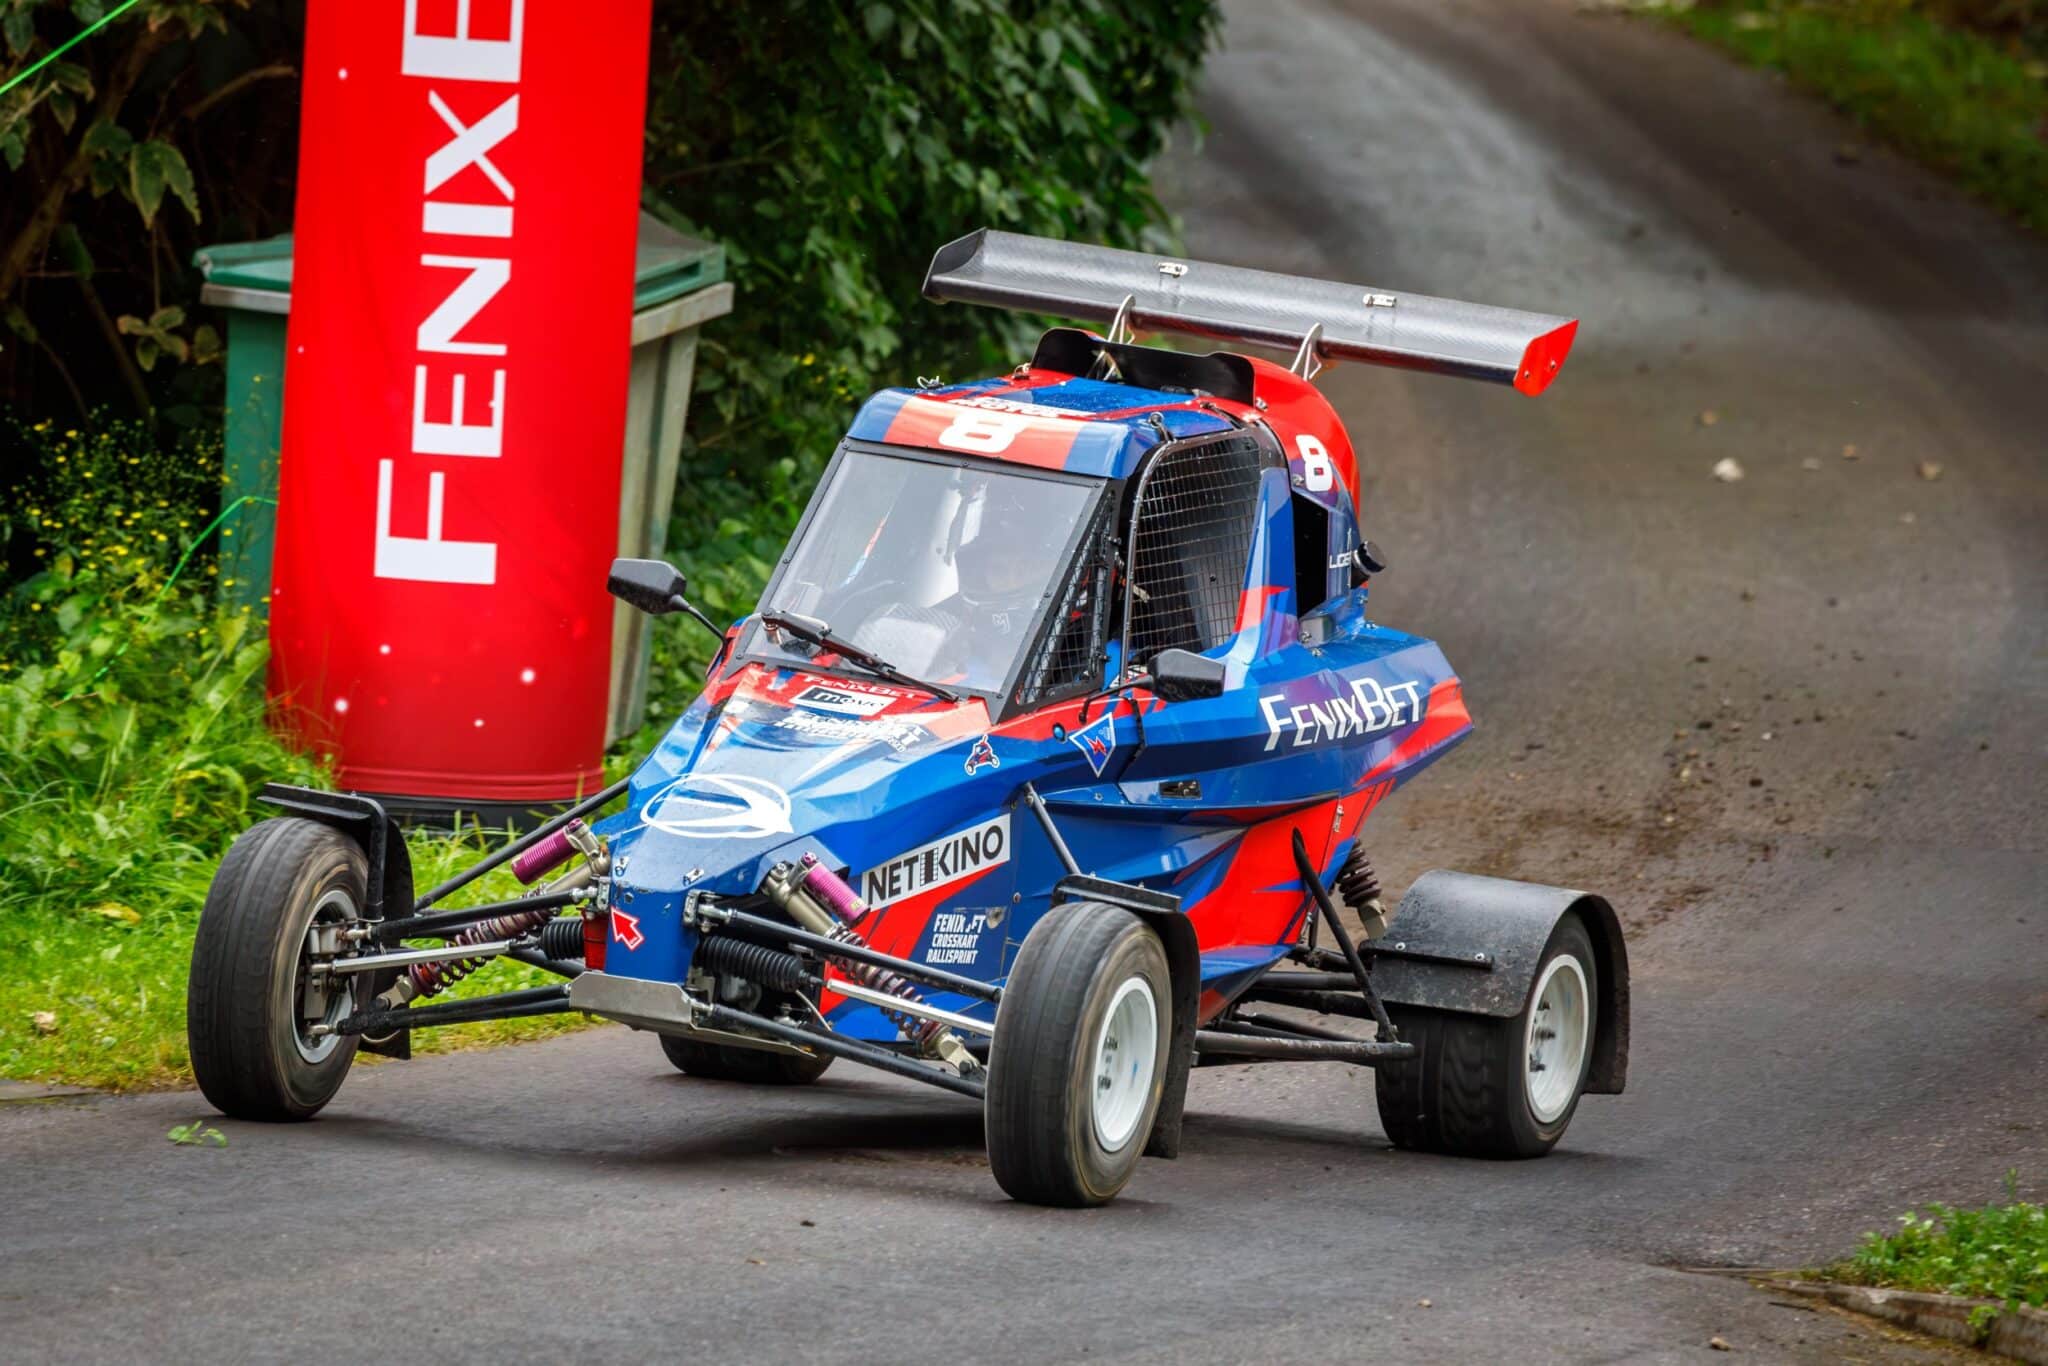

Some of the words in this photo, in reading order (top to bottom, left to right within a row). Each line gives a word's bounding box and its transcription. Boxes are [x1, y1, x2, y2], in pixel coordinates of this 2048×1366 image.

[938, 410, 1021, 454] 8
[1295, 434, 1333, 492] 8
[931, 933, 980, 949] CROSSKART
